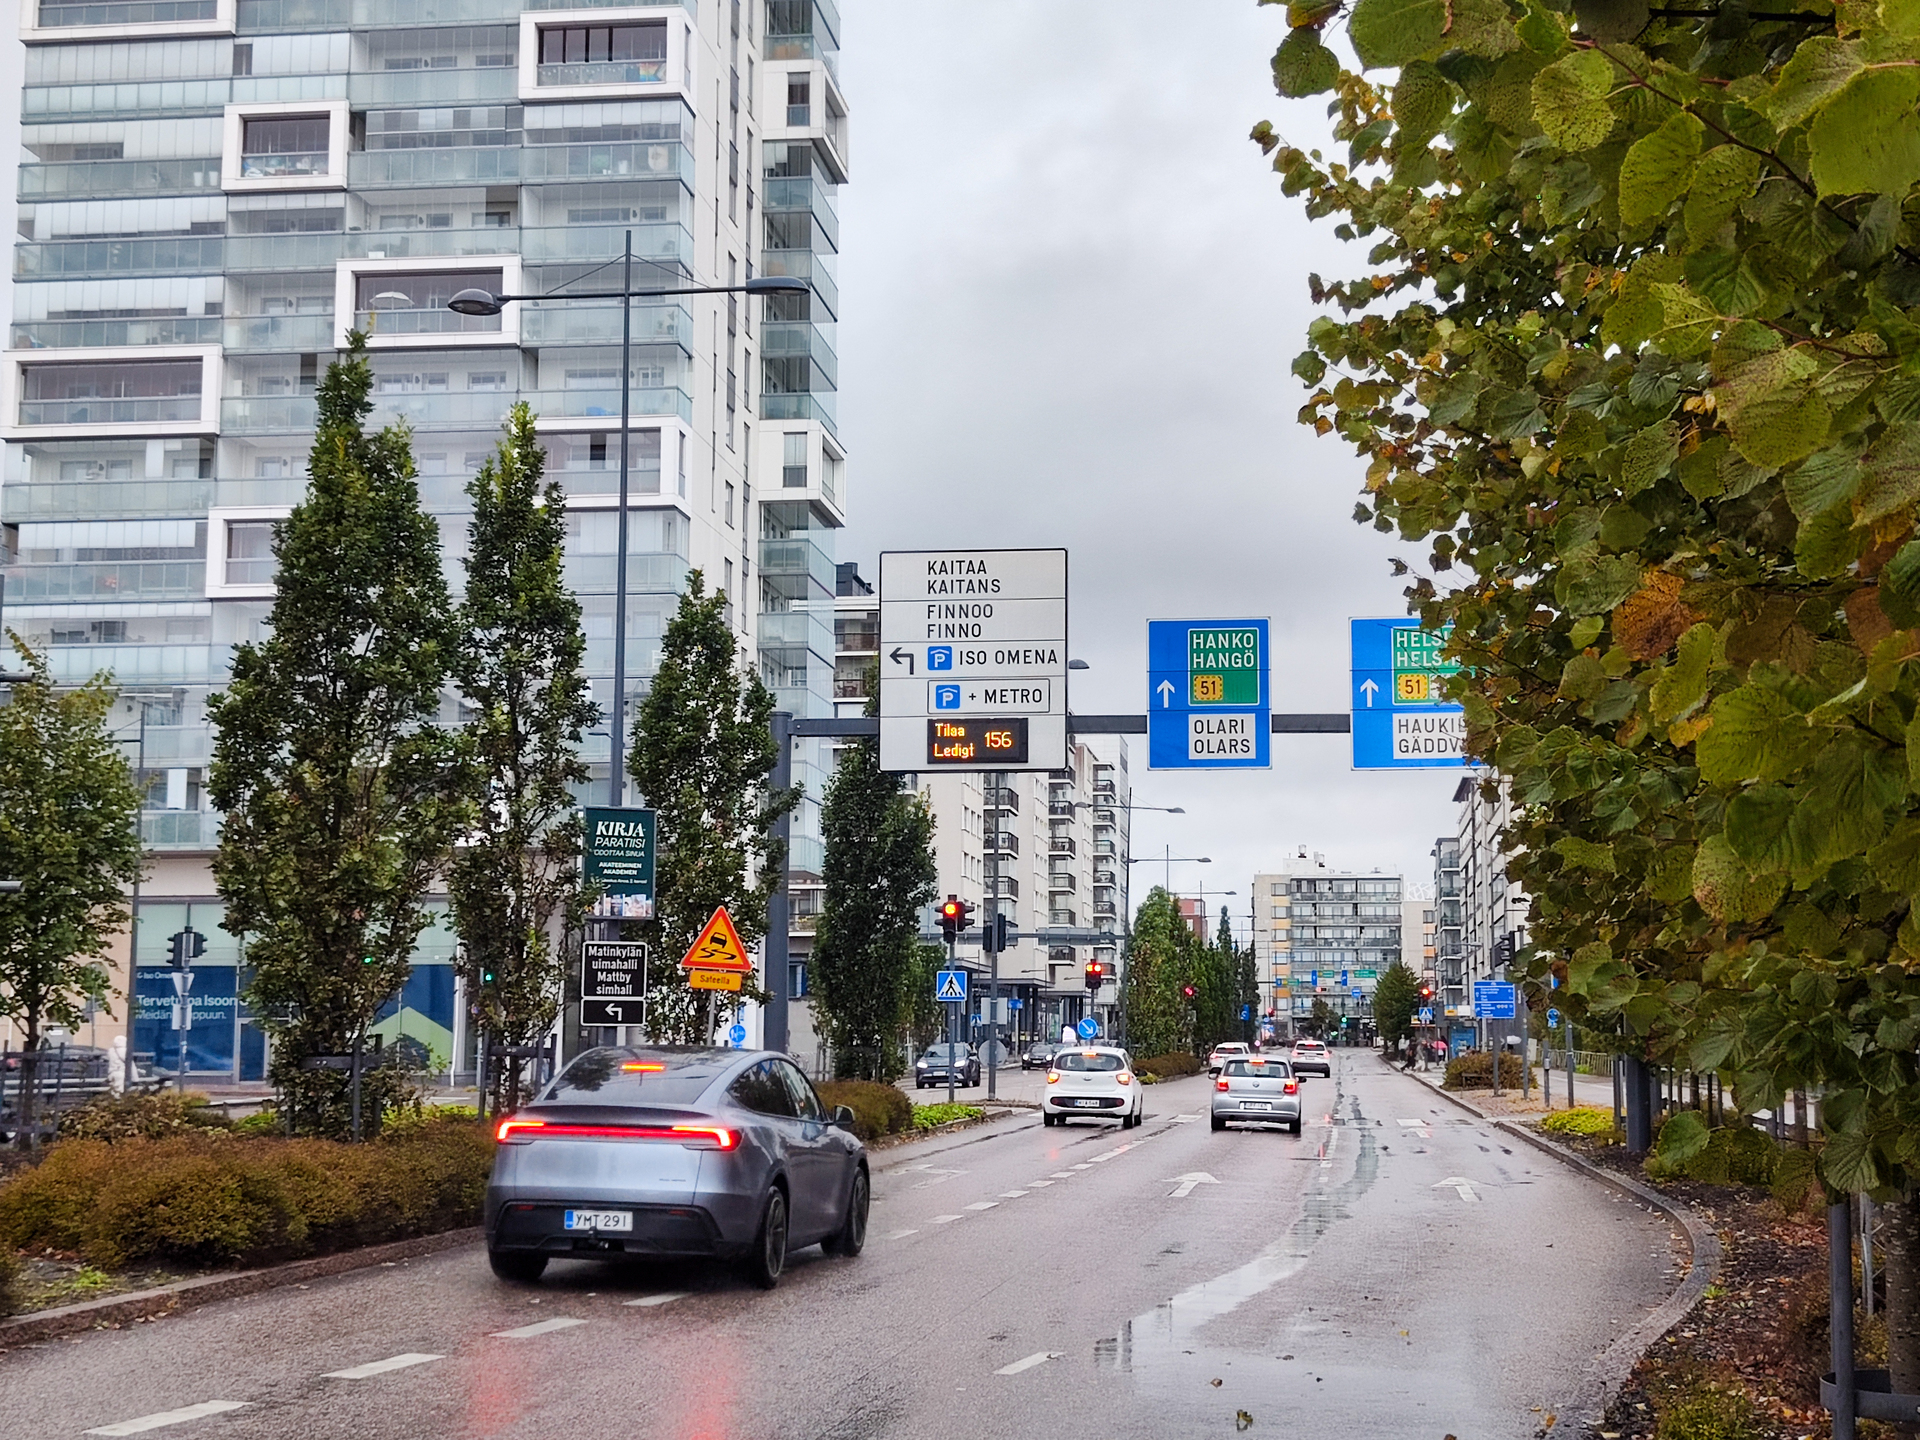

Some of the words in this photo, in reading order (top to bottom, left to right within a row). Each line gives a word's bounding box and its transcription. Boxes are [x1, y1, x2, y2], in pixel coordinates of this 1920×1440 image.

[927, 560, 987, 575] KAITAA
[927, 579, 1001, 594] KAITANS
[927, 604, 993, 619] FINNOO
[927, 623, 982, 639] FINNO
[1193, 632, 1254, 648] HANKO
[1396, 631, 1448, 647] HELSI
[959, 650, 987, 665] ISO
[995, 649, 1058, 664] OMENA
[1193, 651, 1255, 668] HANGÖ
[1201, 680, 1217, 696] 51
[1405, 679, 1420, 694] 51
[984, 688, 1043, 703] METRO
[934, 722, 965, 737] Tilaa
[1194, 719, 1245, 734] OLARI
[984, 731, 1012, 748] 156
[1194, 738, 1250, 754] OLARS
[1398, 736, 1459, 753] GÄDDV
[934, 742, 974, 759] Ledigt
[594, 837, 646, 848] PARATIISI
[593, 849, 624, 857] ODOTTAA
[588, 945, 642, 958] Matinkylän
[592, 959, 637, 969] uimahalli
[155, 971, 173, 979] Ome
[597, 971, 631, 984] Mattby
[700, 974, 730, 985] Sateella
[596, 984, 632, 995] simhall
[136, 995, 202, 1006] Tervetuoa
[204, 994, 237, 1006] Isoon
